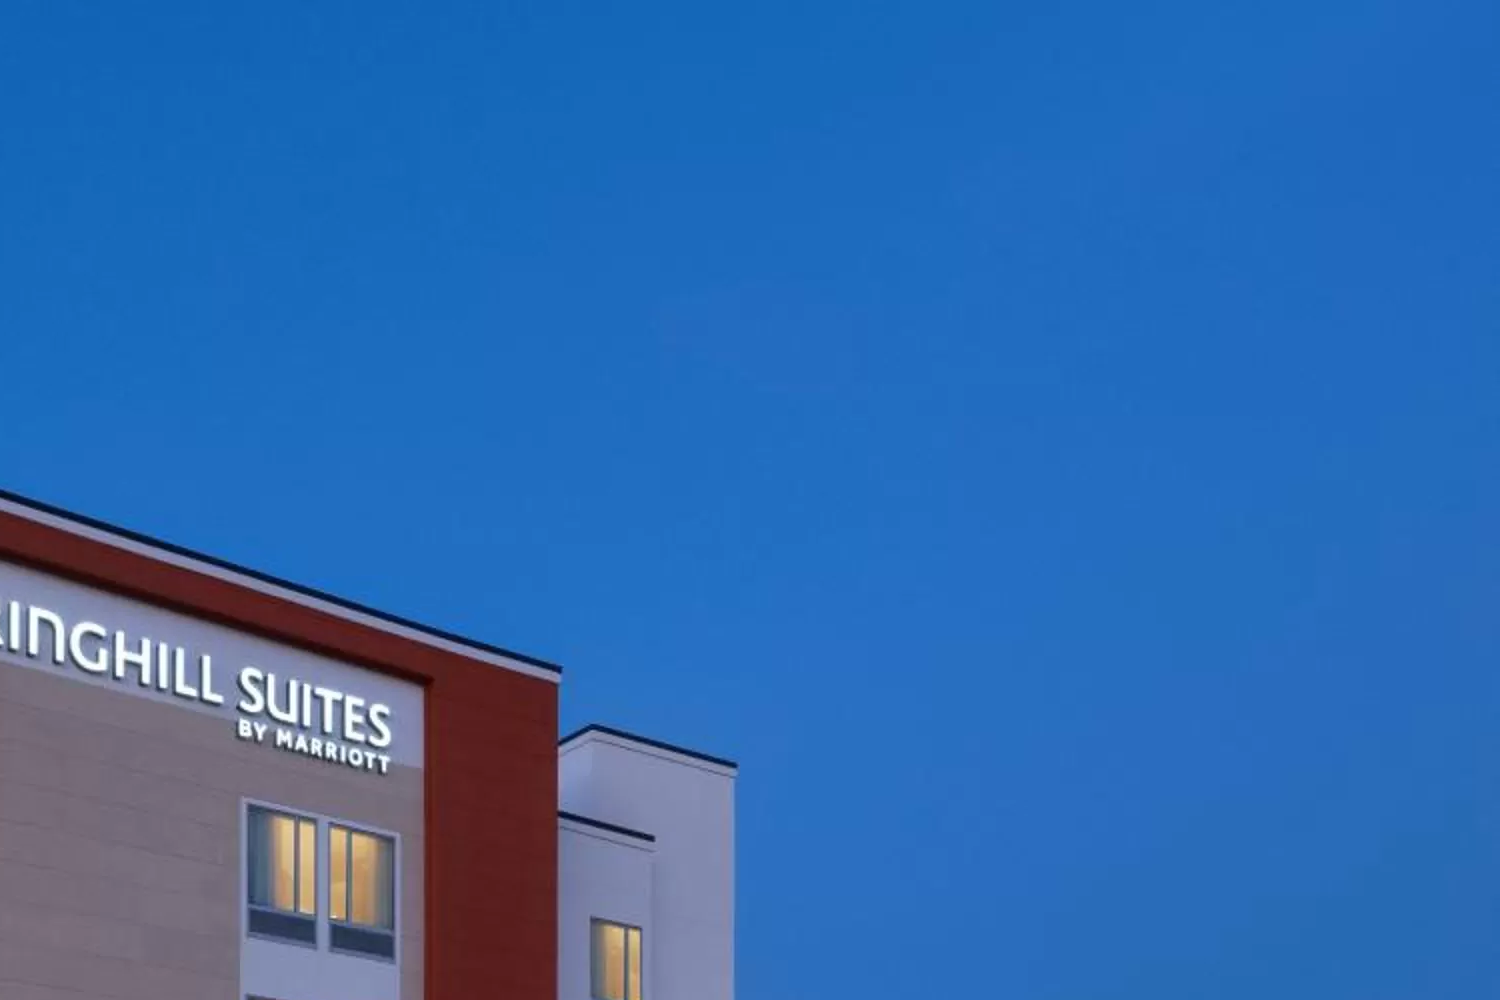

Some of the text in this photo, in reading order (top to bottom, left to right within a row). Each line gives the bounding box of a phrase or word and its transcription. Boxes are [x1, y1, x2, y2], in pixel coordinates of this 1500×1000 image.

[238, 666, 392, 748] SUITES
[238, 719, 391, 775] BY MARRIOTT
